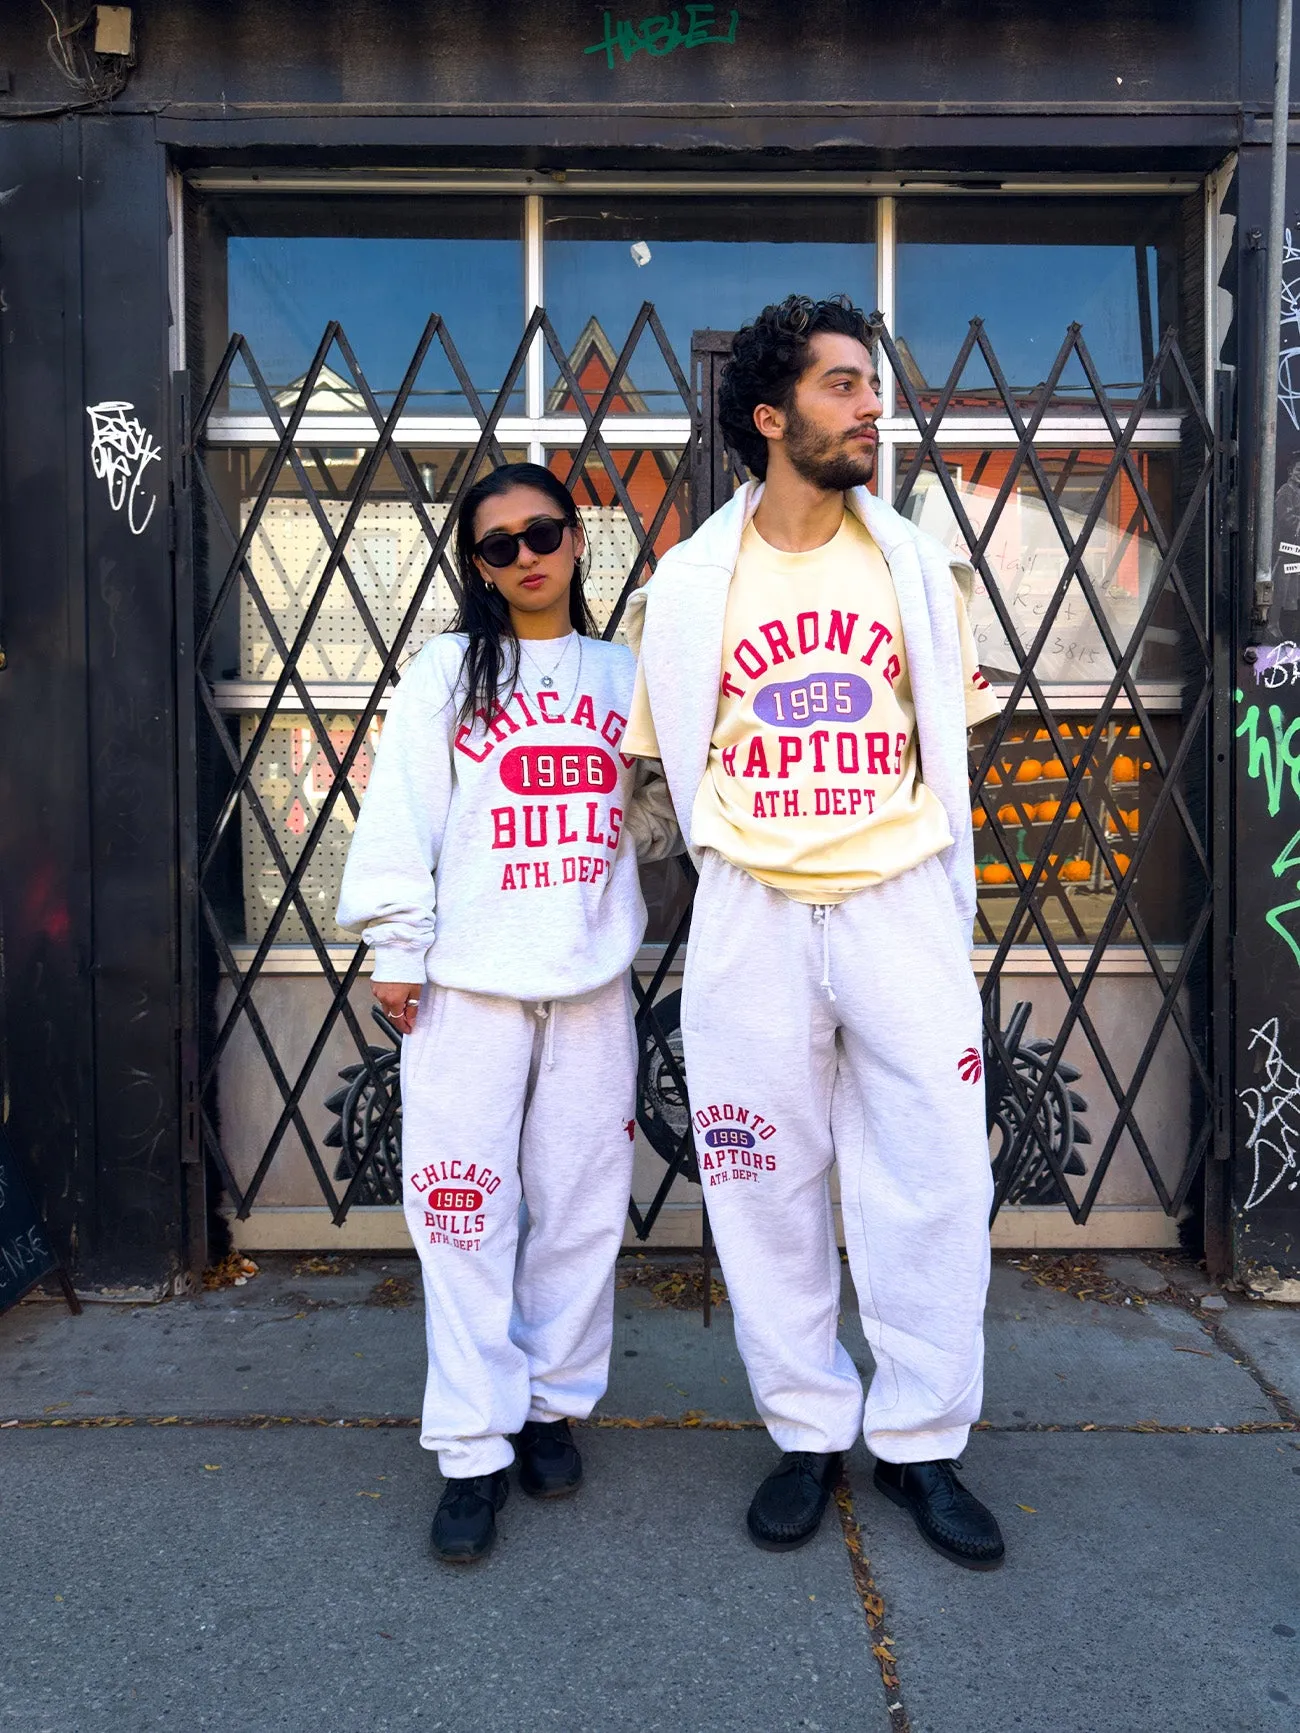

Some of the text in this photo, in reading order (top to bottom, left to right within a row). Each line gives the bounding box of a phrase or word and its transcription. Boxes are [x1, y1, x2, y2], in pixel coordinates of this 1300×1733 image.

[721, 609, 902, 700] TORONTO
[773, 681, 852, 721] 1995
[454, 691, 638, 770] CHICAG
[519, 754, 604, 788] 1966
[490, 801, 624, 851] BULLS
[713, 1131, 749, 1145] 1995
[410, 1160, 502, 1195] CHICAGO
[436, 1192, 475, 1208] 1966
[423, 1210, 486, 1235] BULLS
